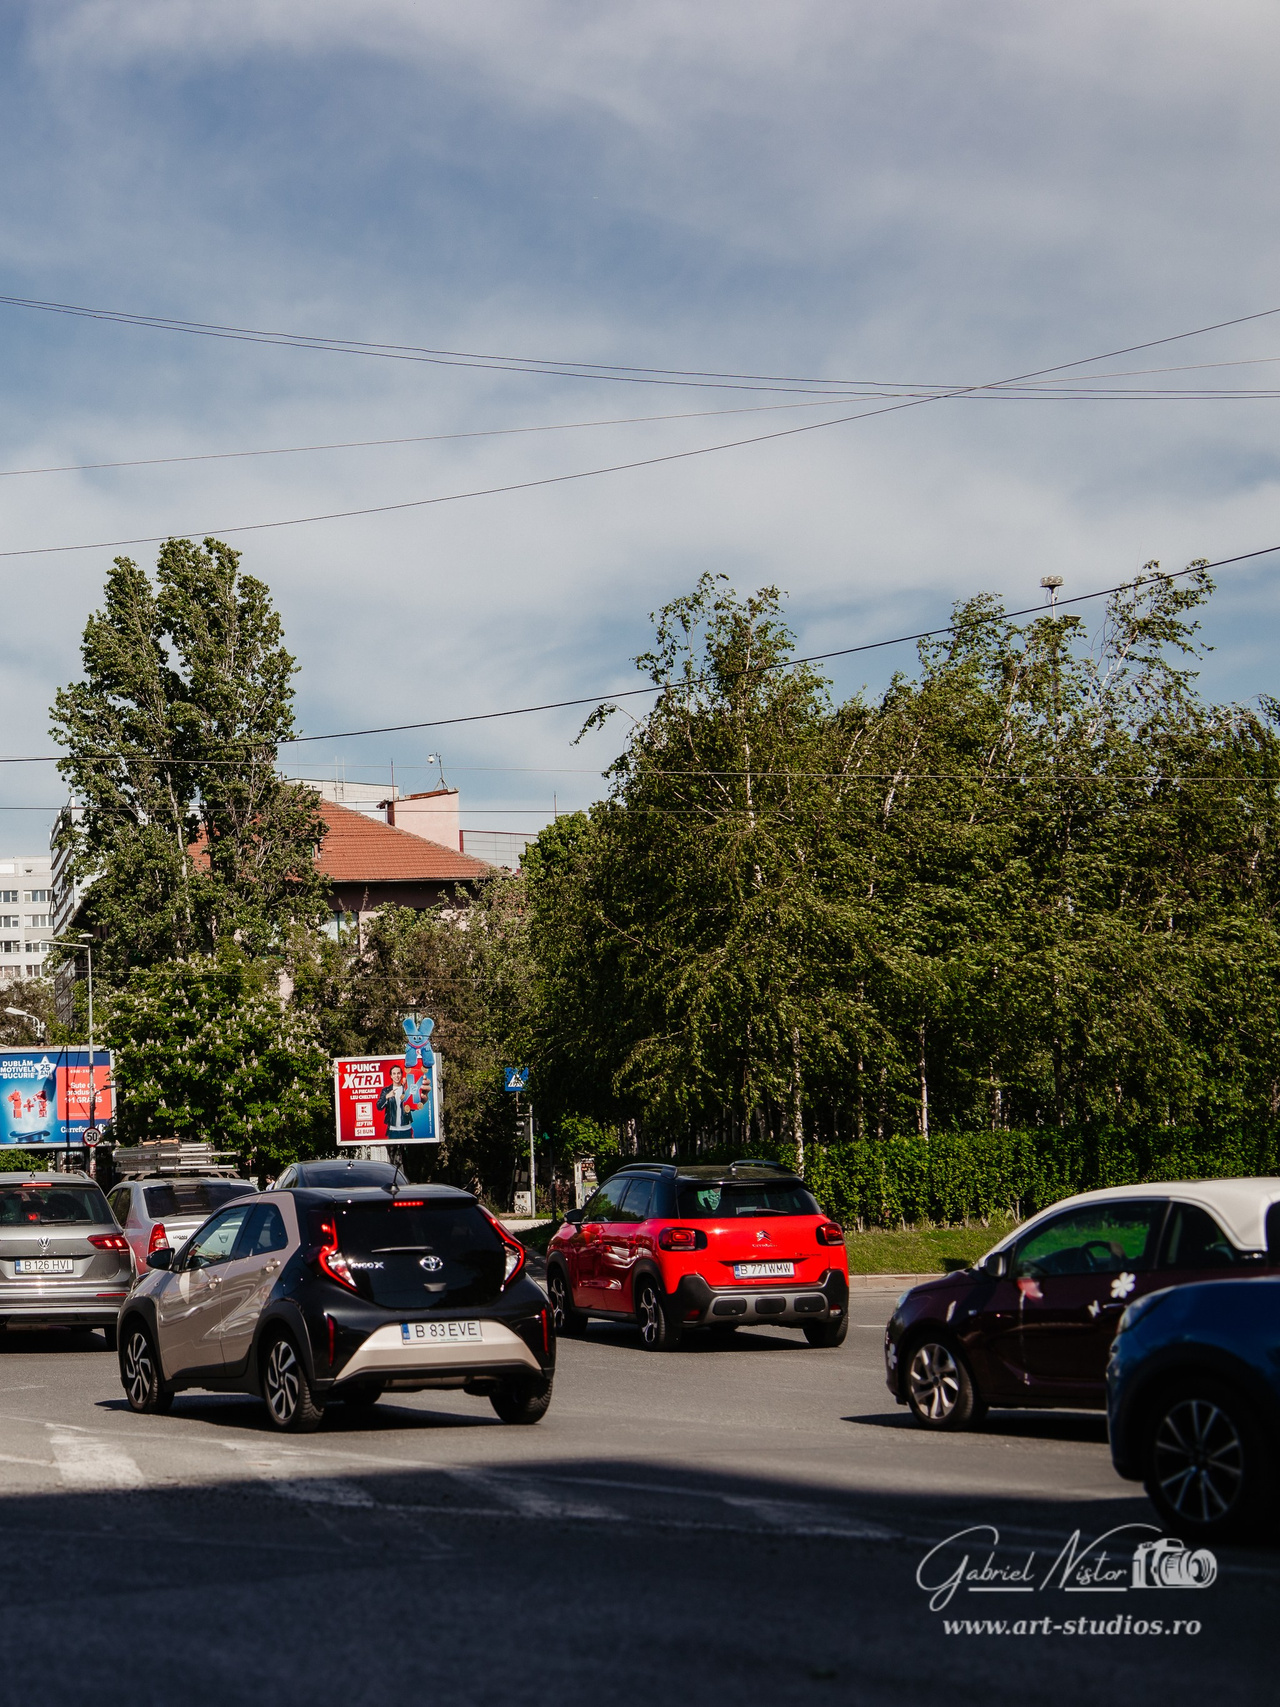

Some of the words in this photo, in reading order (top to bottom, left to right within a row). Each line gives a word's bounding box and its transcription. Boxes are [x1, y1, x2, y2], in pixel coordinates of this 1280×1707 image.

[2, 1059, 33, 1067] DUBLĂM
[345, 1064, 350, 1073] 1
[351, 1063, 380, 1073] PUNCT
[342, 1073, 382, 1089] XTRA
[87, 1132, 98, 1142] 50
[24, 1261, 31, 1270] B
[34, 1260, 50, 1270] 126
[52, 1260, 69, 1270] HVI
[740, 1264, 748, 1275] B
[415, 1324, 425, 1338] B
[429, 1324, 445, 1337] 83
[449, 1322, 477, 1336] EVE
